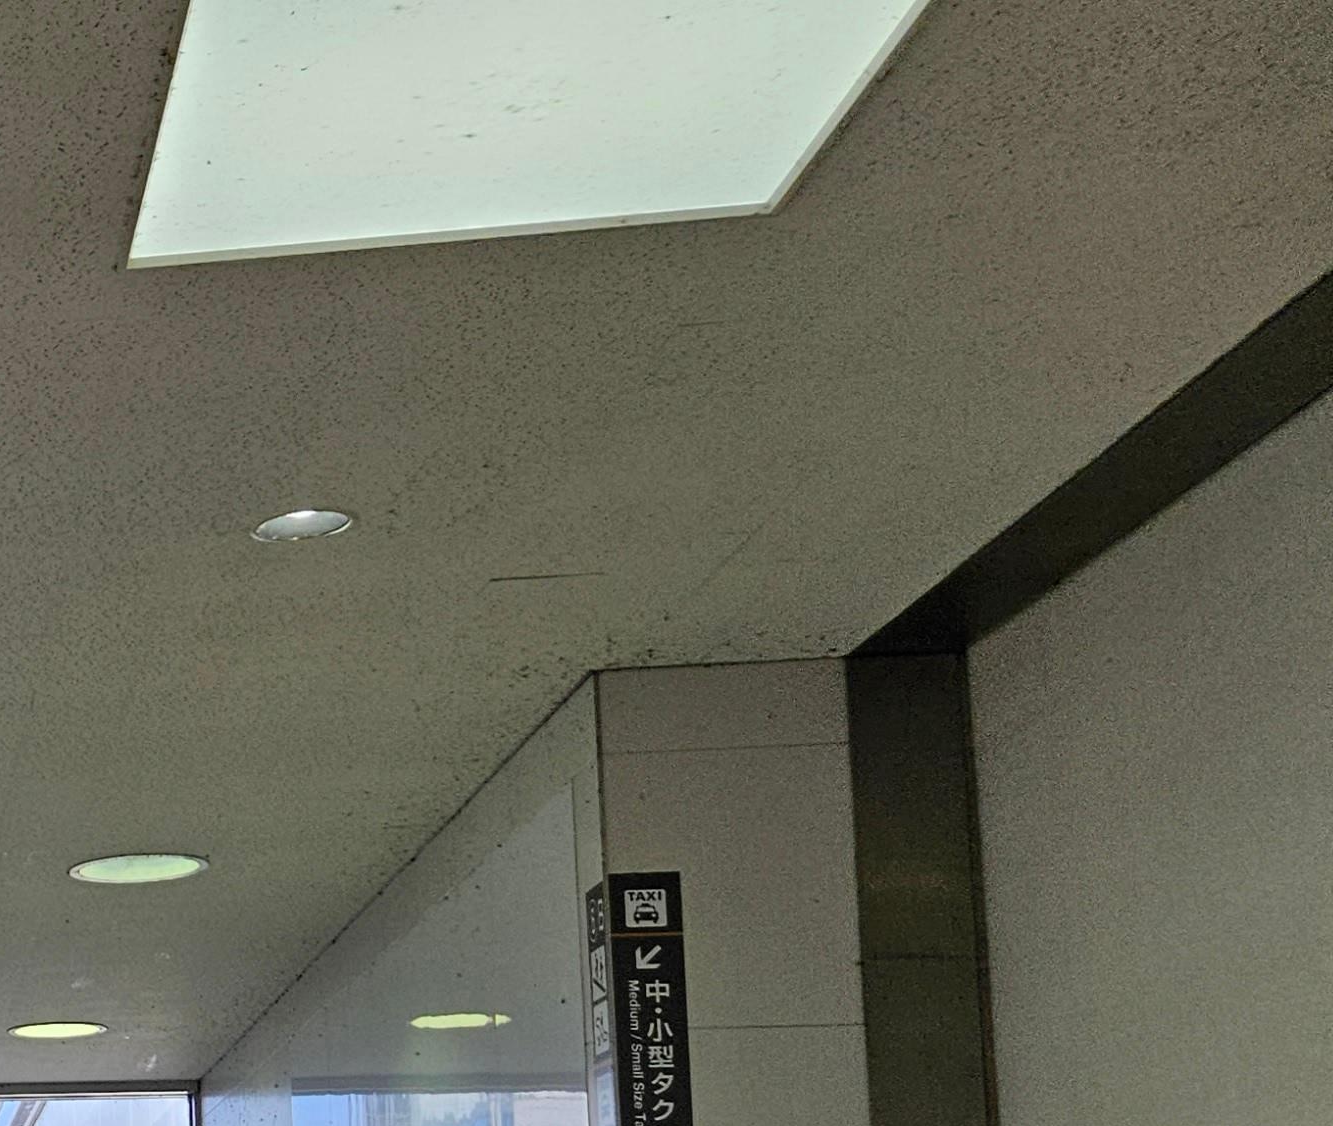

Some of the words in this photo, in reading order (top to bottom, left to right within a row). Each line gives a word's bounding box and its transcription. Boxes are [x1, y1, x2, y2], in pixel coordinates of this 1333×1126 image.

[628, 891, 662, 901] TAXI
[629, 979, 640, 1031] Medium
[631, 1043, 644, 1078] Small
[633, 1082, 645, 1109] Size
